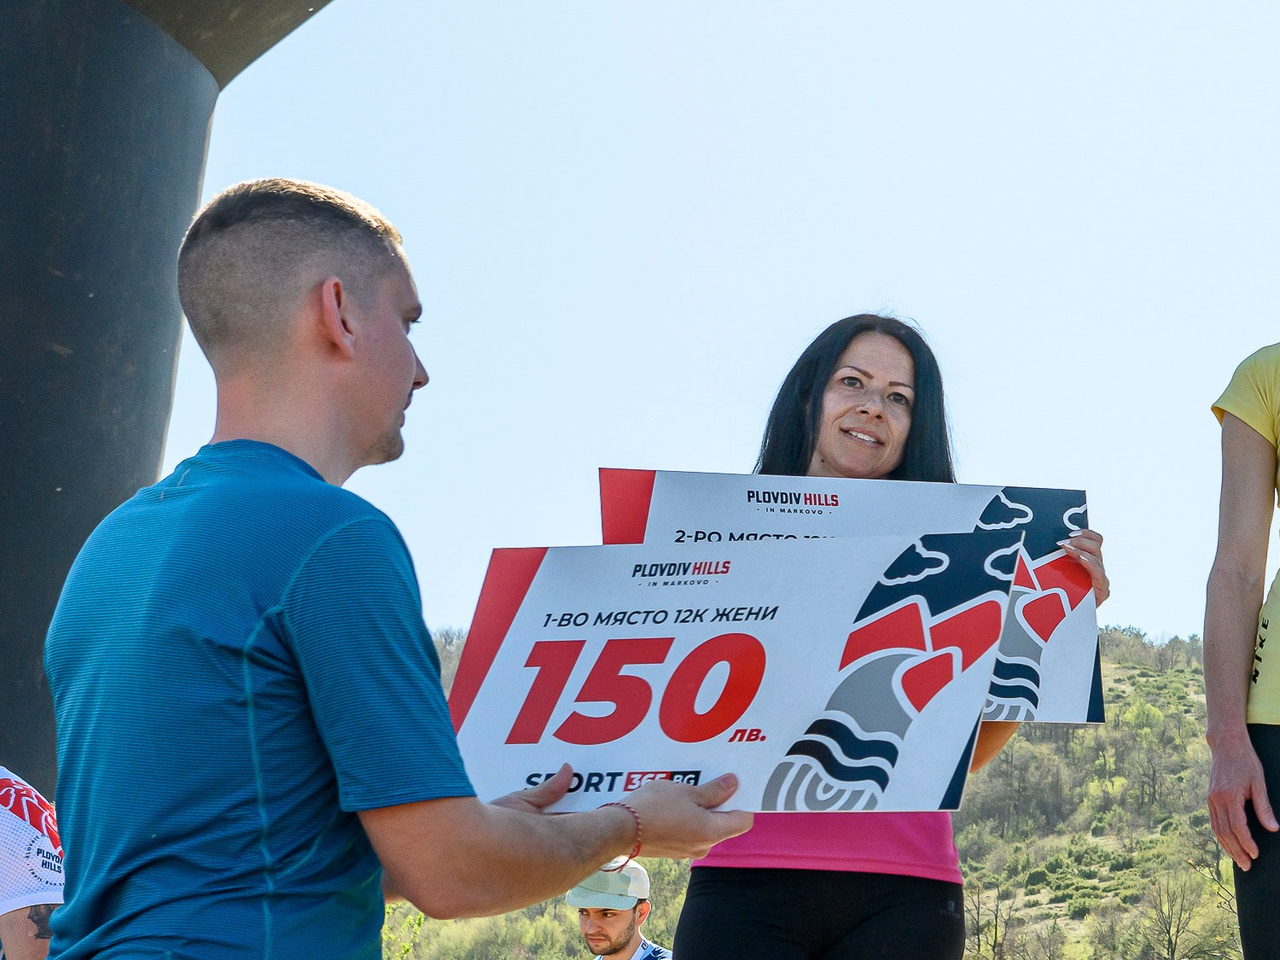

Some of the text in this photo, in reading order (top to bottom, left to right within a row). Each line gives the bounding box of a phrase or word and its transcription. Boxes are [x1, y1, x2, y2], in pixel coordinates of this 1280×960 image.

[747, 490, 839, 507] PLOVDIV HILLS
[674, 529, 722, 543] 2-РО
[631, 560, 732, 578] PLOVDIV HILLS
[662, 579, 710, 587] MARKOVO
[542, 605, 780, 628] 1-ВО МЯСТО 12К ЖЕНИ
[1252, 617, 1270, 685] NIKE
[504, 632, 767, 746] 150
[524, 771, 624, 793] SORT
[36, 848, 63, 865] PLOVDI
[41, 860, 62, 874] HILLS
